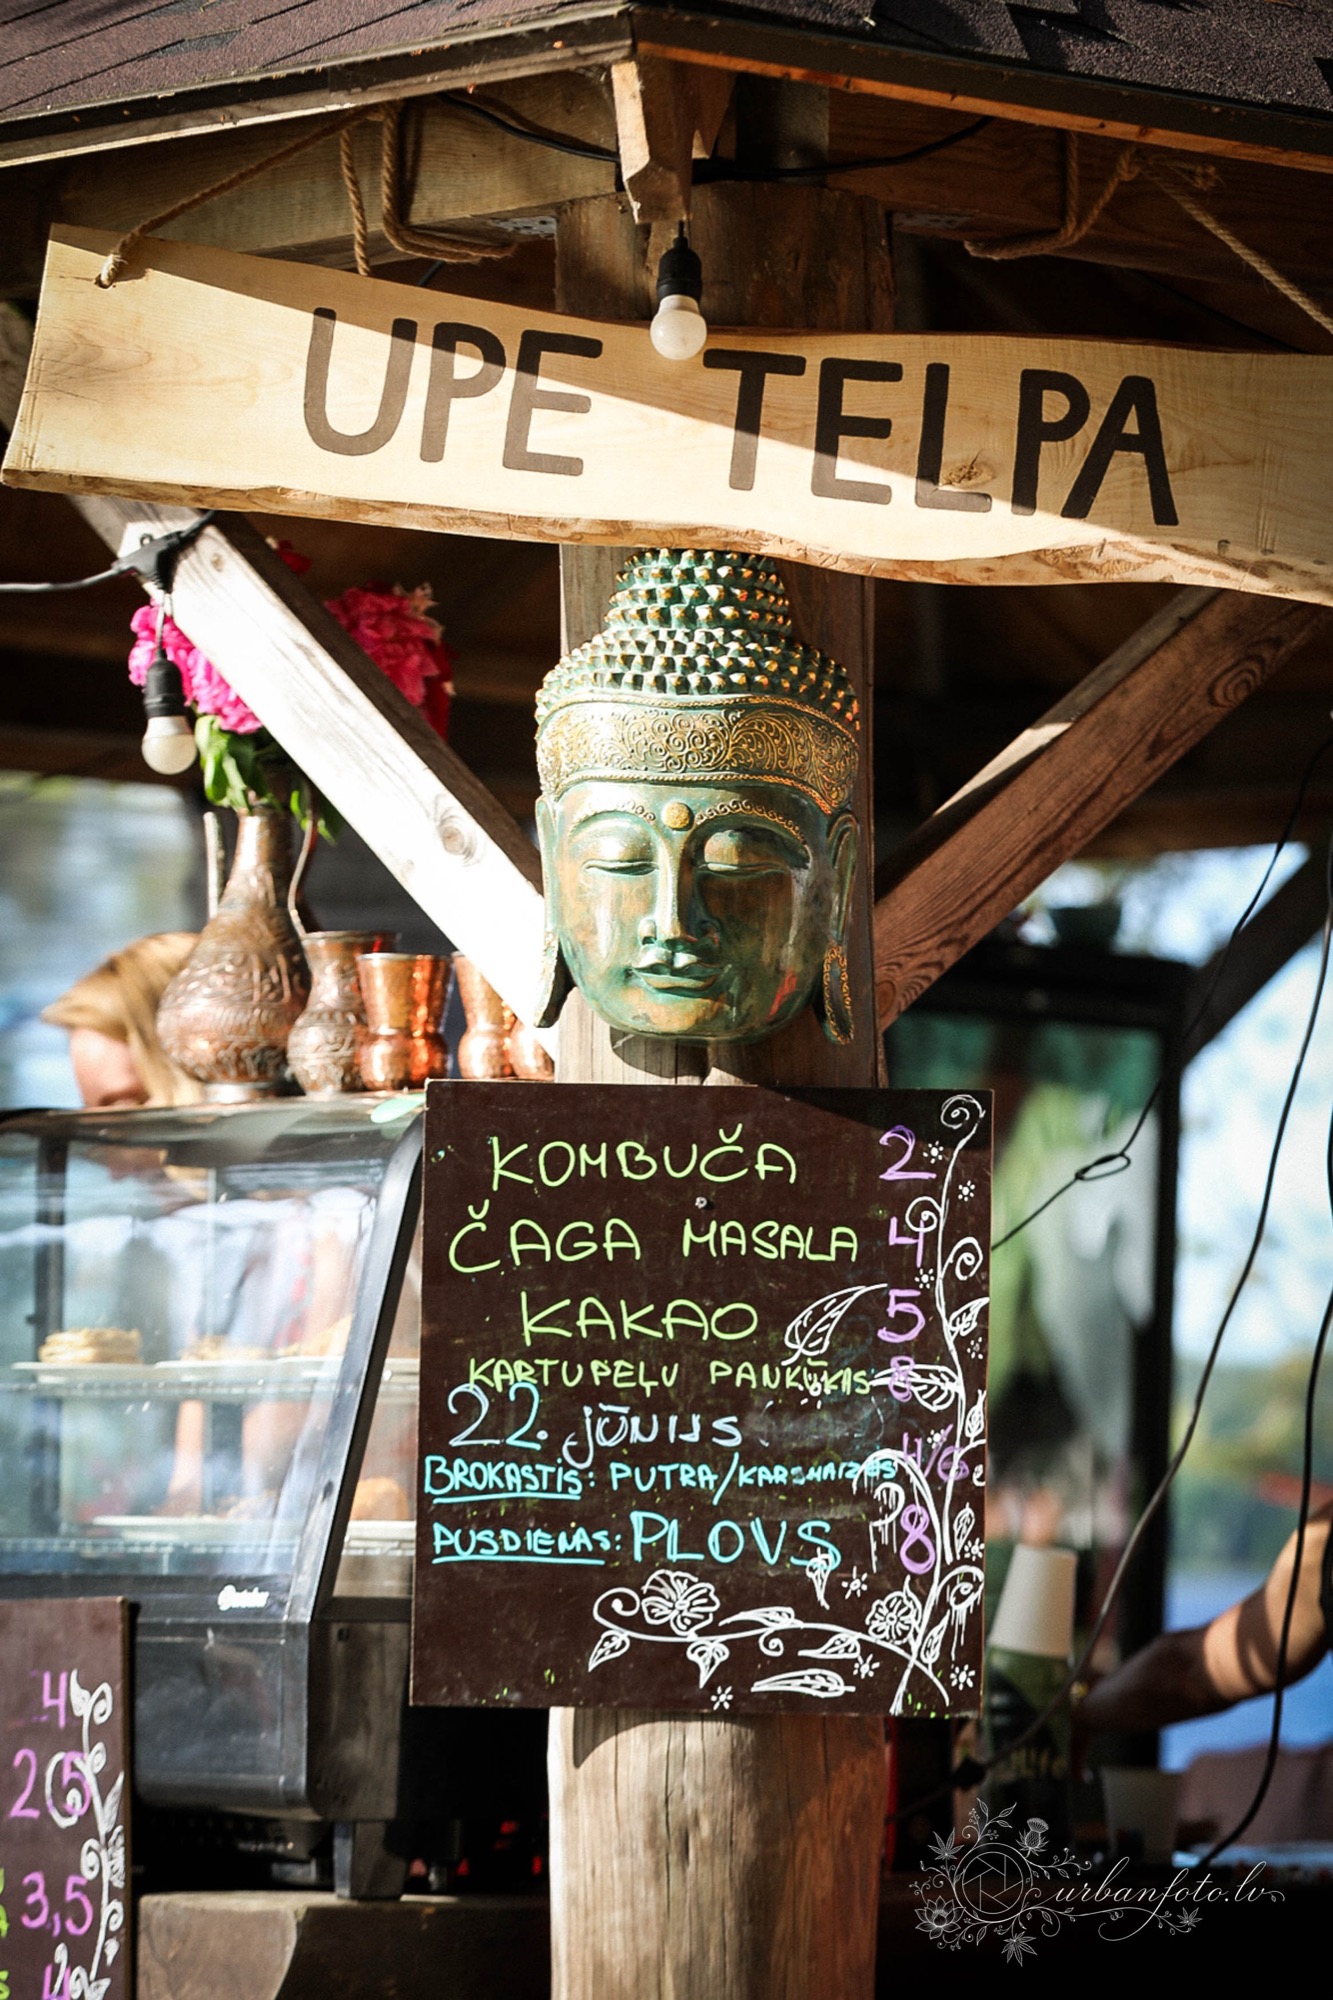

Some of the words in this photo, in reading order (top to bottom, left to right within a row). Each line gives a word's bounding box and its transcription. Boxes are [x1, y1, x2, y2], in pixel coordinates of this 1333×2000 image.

[303, 307, 603, 476] UPE
[703, 349, 1179, 525] TELPA
[491, 1123, 797, 1191] KOMBUČA
[879, 1125, 936, 1181] 2
[448, 1199, 641, 1274] ČAGA
[681, 1218, 858, 1263] MASALA
[888, 1216, 924, 1268] 4
[520, 1291, 759, 1346] KAKAO
[877, 1288, 925, 1343] 5
[468, 1358, 680, 1397] KARTUPEĻU
[710, 1358, 871, 1395] PANKŪKAS
[629, 1510, 842, 1571] PLOVS
[900, 1503, 936, 1575] 8
[43, 1670, 68, 1729] 4
[21, 1870, 93, 1937] 3,5
